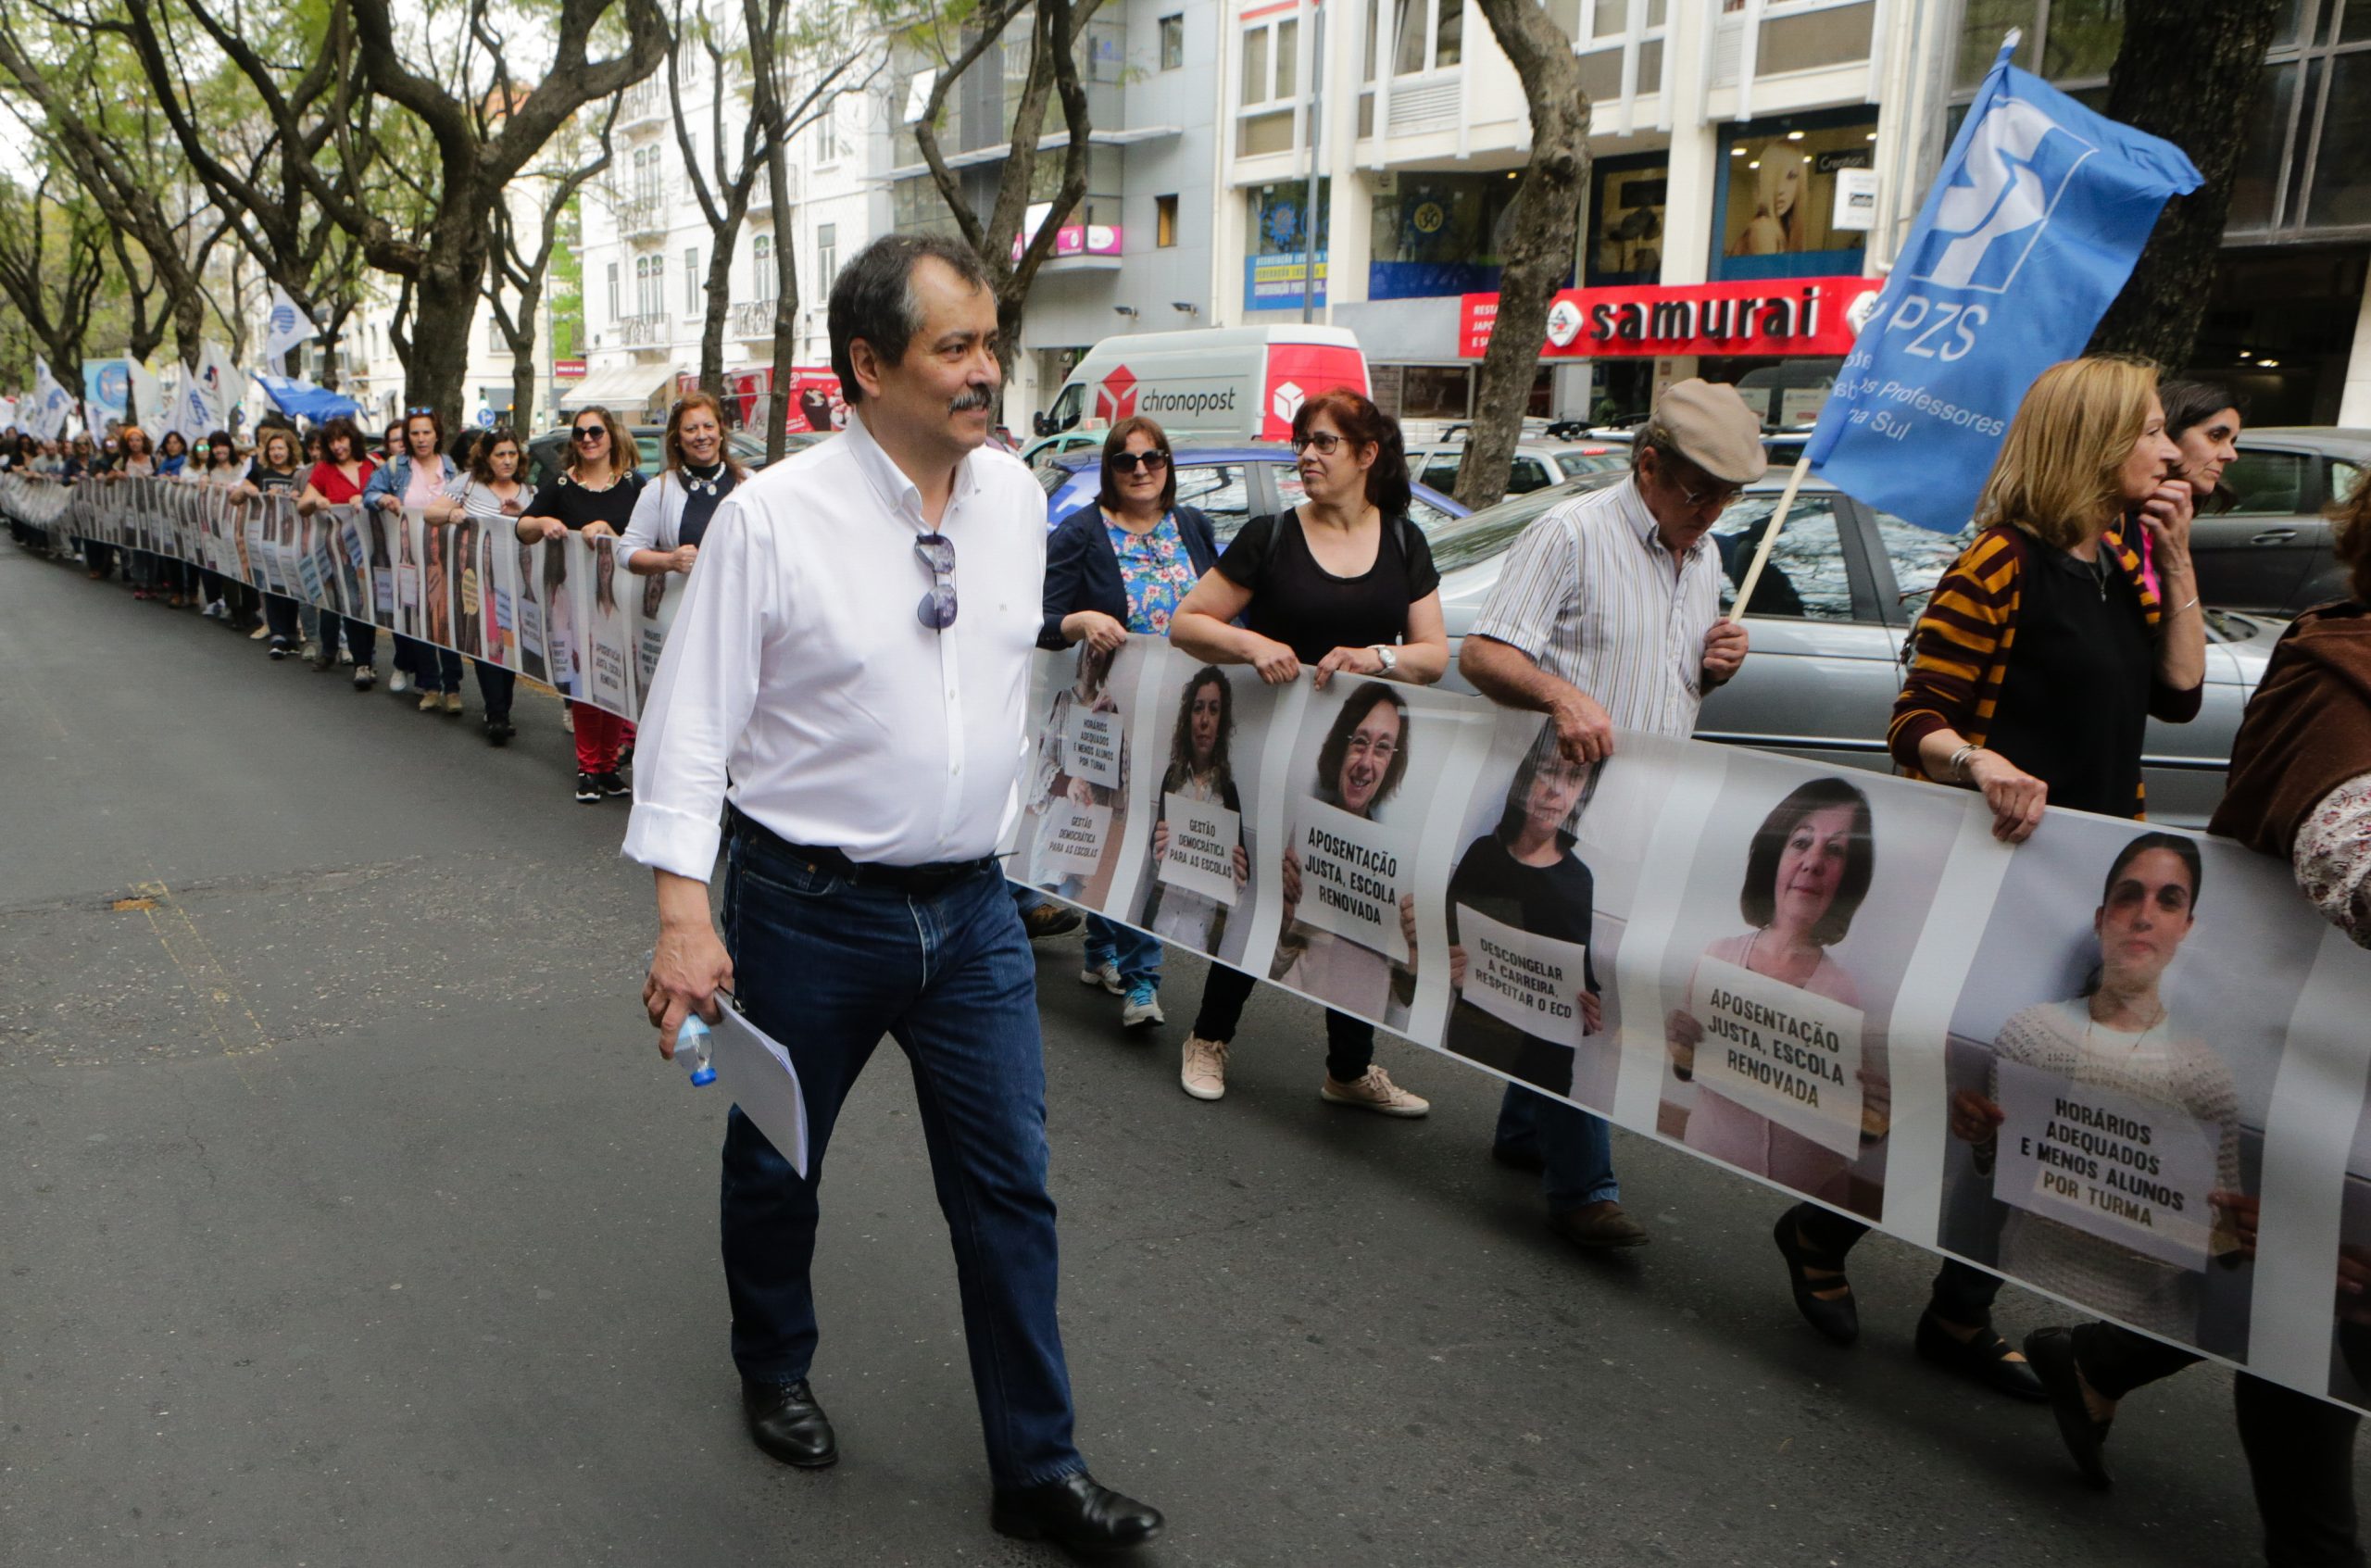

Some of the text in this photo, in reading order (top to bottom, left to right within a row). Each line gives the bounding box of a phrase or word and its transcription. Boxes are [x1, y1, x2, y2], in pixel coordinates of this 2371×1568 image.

[1590, 286, 1820, 341] samurai
[1142, 385, 1236, 417] chronopost
[1878, 380, 2005, 438] Professores
[1871, 410, 1913, 441] Sul
[1048, 841, 1098, 858] PARA AS ESCOLAS
[1179, 834, 1224, 858] DEMOCRÁTICA
[1190, 819, 1215, 837] GESTÃO
[1308, 826, 1397, 878] APOSENTAÇÃO
[1169, 848, 1232, 879] PARA AS ESCOLAS
[1305, 854, 1396, 907] JUSTA, ESCOLA
[1319, 884, 1381, 925] RENOVADA
[1480, 938, 1563, 981] DESCONGELAR
[1487, 959, 1559, 998] A CARREIRA,
[1475, 969, 1533, 1007] RESPEITAR
[1538, 998, 1546, 1011] O
[1710, 988, 1839, 1053] APOSENTAÇÃO
[1708, 1015, 1845, 1086] JUSTA, ESCOLA
[1727, 1048, 1819, 1109] RENOVADA
[2055, 1098, 2152, 1146] HORÁRIOS
[2046, 1121, 2161, 1176] ADEQUADOS
[2021, 1136, 2185, 1211] E MENOS ALUNOS
[2043, 1171, 2153, 1228] POR TURMA
